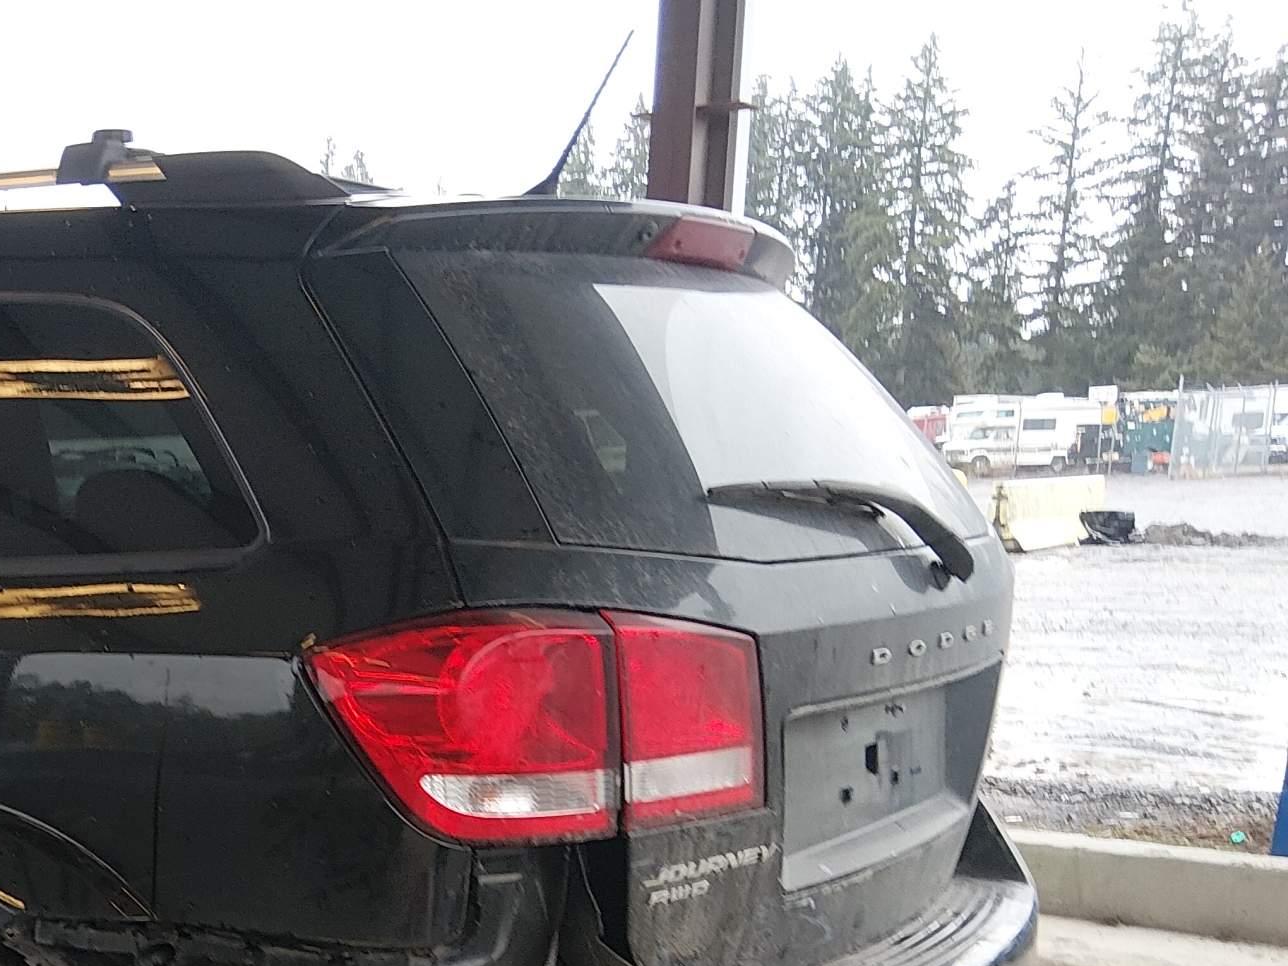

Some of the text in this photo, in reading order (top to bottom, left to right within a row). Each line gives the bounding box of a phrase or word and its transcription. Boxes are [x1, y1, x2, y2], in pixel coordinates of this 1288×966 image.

[870, 618, 993, 666] DODGE
[640, 842, 780, 889] JOURNEY
[648, 879, 710, 908] AWD
